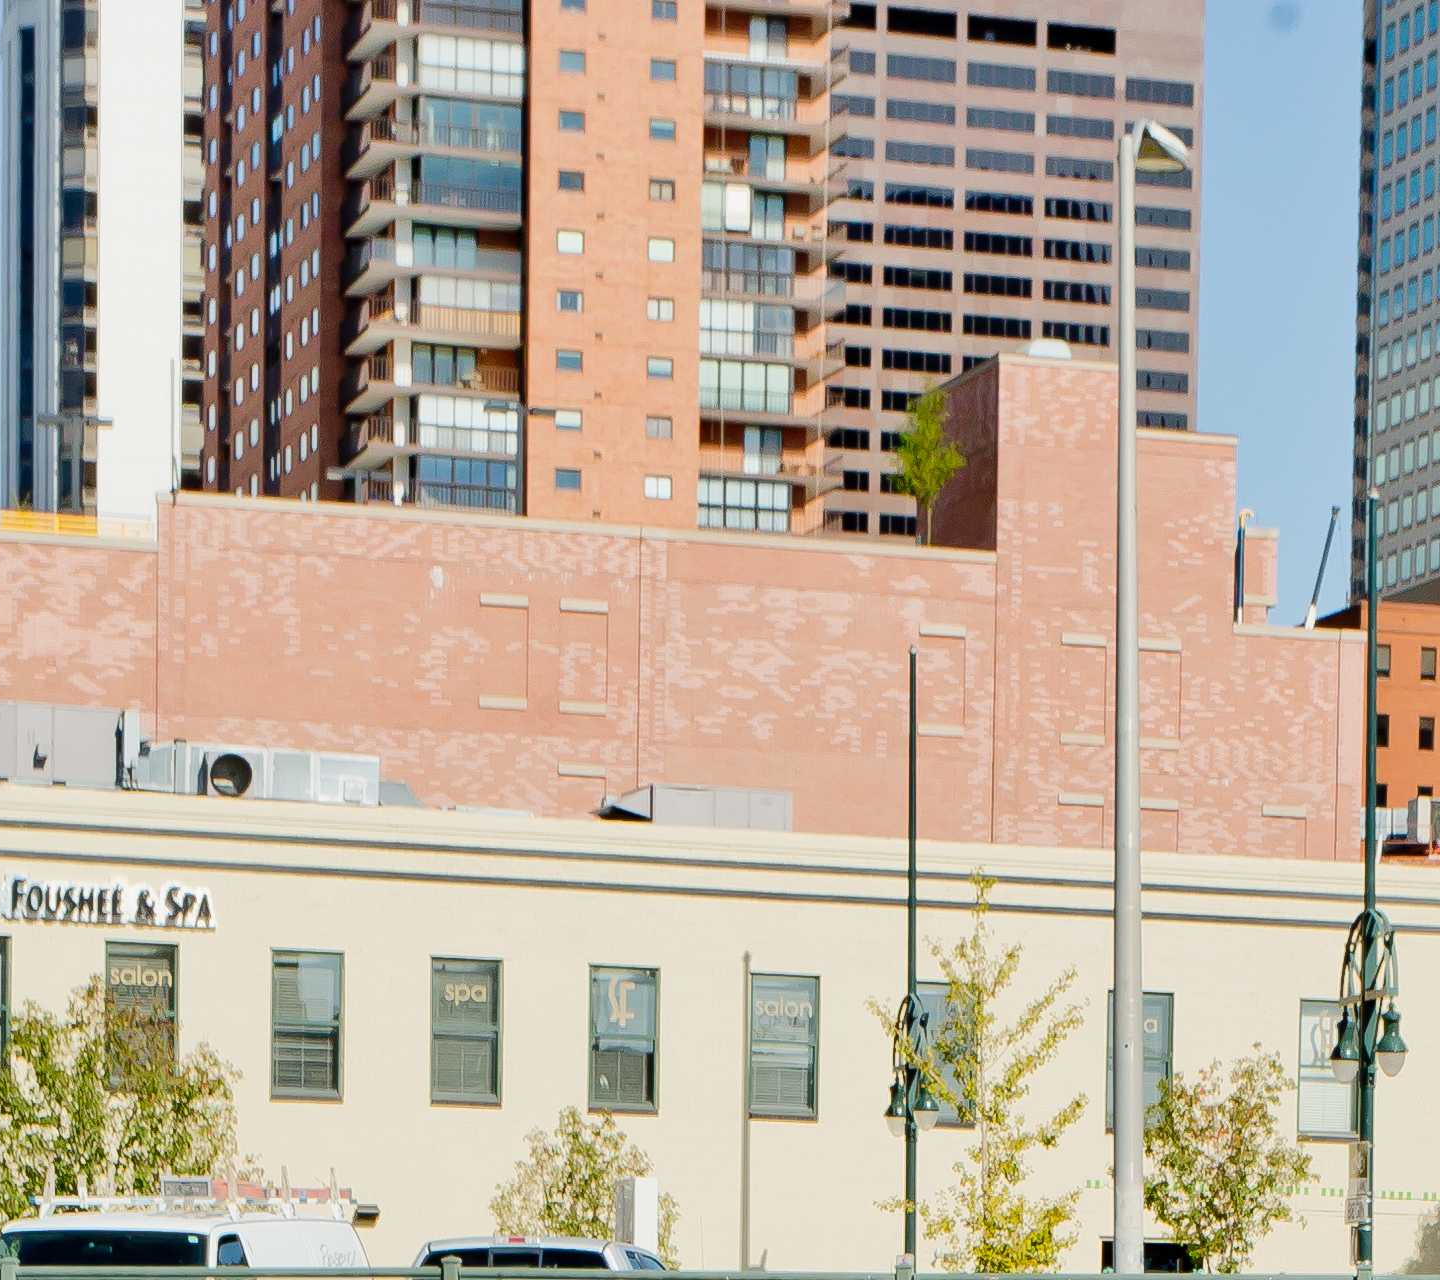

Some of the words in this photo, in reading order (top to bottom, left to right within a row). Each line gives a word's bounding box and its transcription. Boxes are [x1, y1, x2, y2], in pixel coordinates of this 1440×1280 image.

[137, 889, 156, 921] &
[110, 965, 173, 988] salon
[444, 983, 487, 1007] spa
[755, 993, 813, 1018] salon
